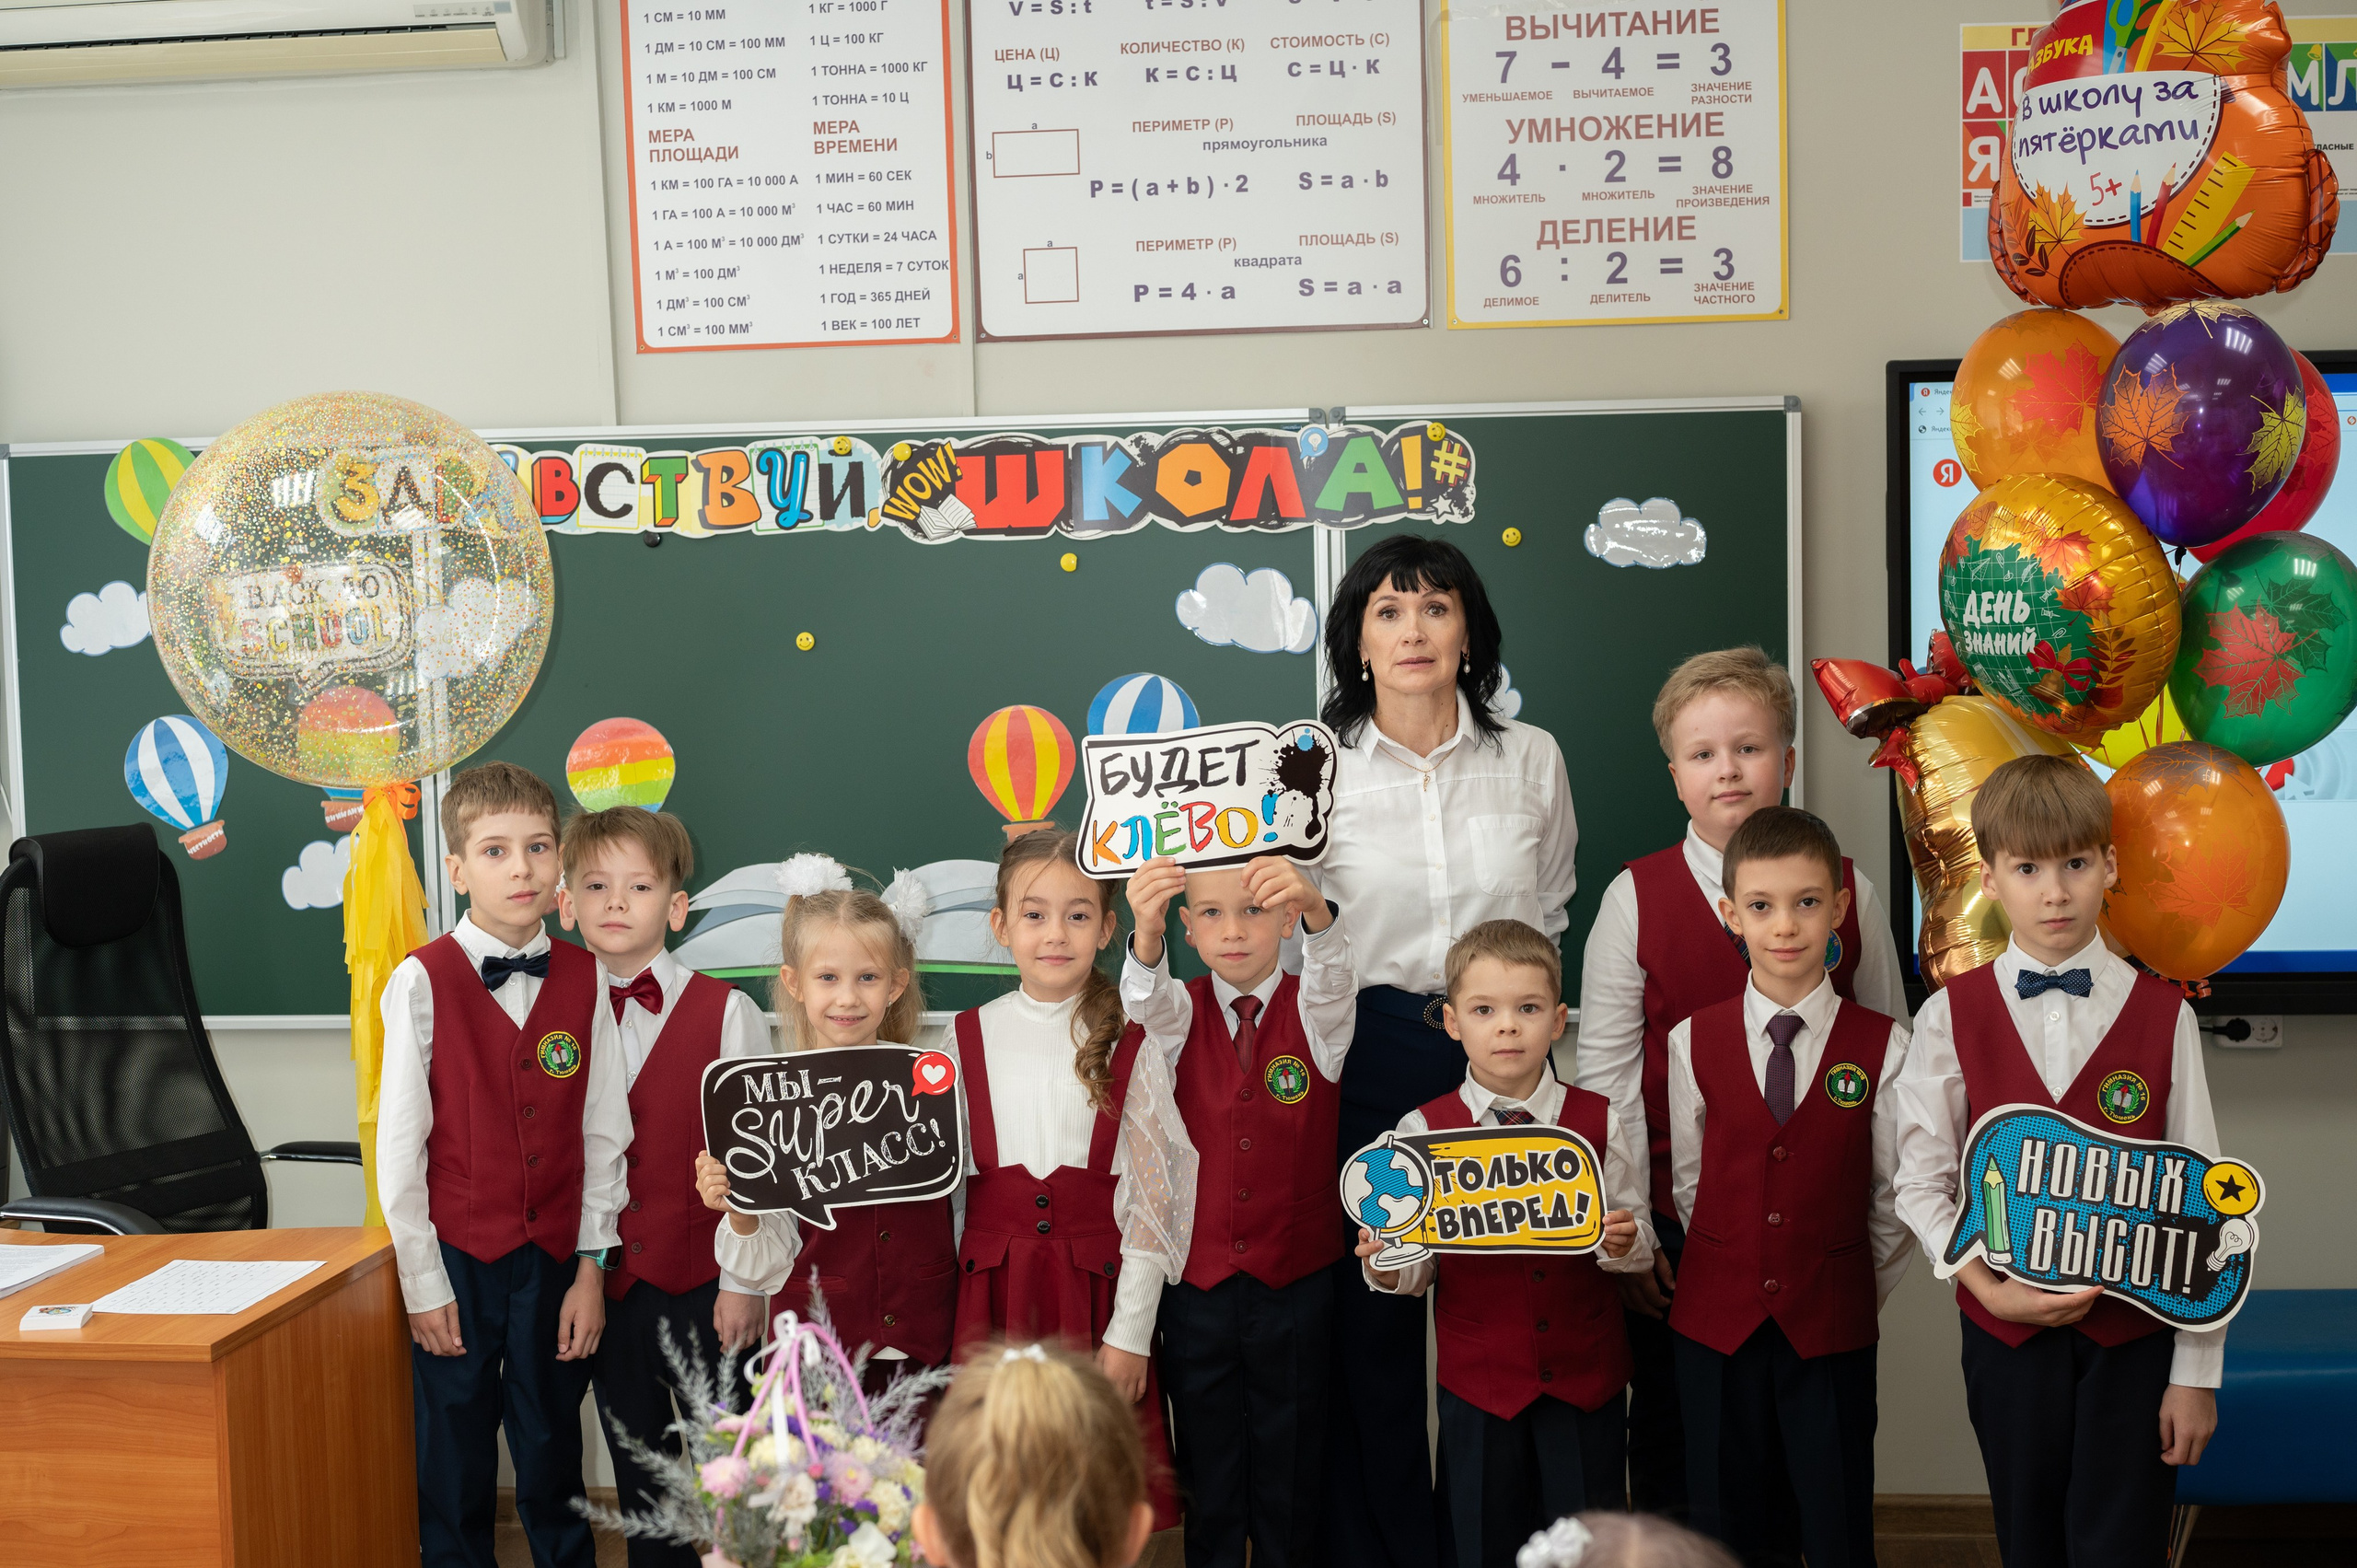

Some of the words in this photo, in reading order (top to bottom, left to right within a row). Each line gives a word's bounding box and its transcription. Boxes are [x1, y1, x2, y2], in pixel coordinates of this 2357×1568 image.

[819, 3, 834, 14] КГ
[849, 1, 877, 12] 1000
[654, 12, 673, 23] СМ
[688, 10, 702, 21] 10
[705, 9, 726, 20] ММ
[1506, 8, 1720, 41] ВЫЧИТАНИЕ
[1120, 40, 1222, 54] КОЛИЧЕСТВО
[1226, 38, 1245, 53] (К)
[1271, 34, 1364, 49] СТОИМОСТЬ
[1370, 33, 1389, 48] (С)
[995, 48, 1036, 63] ЦЕНА
[1040, 47, 1060, 63] (Ц)
[2027, 34, 2093, 75] АЗБУКА
[821, 64, 866, 75] ТОННА
[881, 63, 909, 74] 1000
[913, 62, 928, 72] КГ
[1573, 87, 1655, 99] ВЫЧИТАЕМОЕ
[1691, 81, 1752, 92] ЗНАЧЕНИЕ
[1966, 66, 2003, 113] А
[1462, 91, 1552, 103] УМЕНЬШАЕМОЕ
[1691, 94, 1752, 105] РАЗНОСТИ
[2022, 95, 2032, 122] В
[2038, 85, 2142, 118] школу
[2155, 79, 2199, 102] за
[813, 120, 860, 134] МЕРА
[1132, 119, 1211, 133] ПЕРИМЕТР
[1215, 118, 1234, 133] (P)
[1296, 112, 1373, 127] ПЛОЩАДЬ
[1377, 111, 1396, 126] (S)
[1505, 111, 1724, 144] УМНОЖЕНИЕ
[648, 128, 695, 144] МЕРА
[2019, 120, 2200, 164] пятёрками
[814, 138, 897, 155] ВРЕМЕНИ
[1202, 137, 1328, 153] прямоугольника
[649, 145, 738, 163] ПЛОЩАДИ
[826, 172, 853, 183] МИН
[869, 171, 883, 181] 60
[887, 170, 911, 181] СЕК
[1582, 190, 1655, 201] МНОЖИТЕЛЬ
[1692, 184, 1753, 195] ЗНАЧЕНИЕ
[2090, 172, 2122, 206] 5+
[1473, 193, 1546, 204] МНОЖИТЕЛЬ
[1677, 196, 1770, 208] ПРОИЗВЕДЕНИЯ
[827, 203, 853, 214] ЧАС
[868, 202, 882, 212] 60
[886, 200, 914, 211] МИН
[828, 232, 869, 244] СУТКИ
[884, 231, 898, 242] 24
[901, 230, 937, 241] ЧАСА
[1299, 233, 1376, 247] ПЛОЩАДЬ
[1380, 232, 1399, 247] (S)
[1537, 215, 1696, 250] ДЕЛЕНИЕ
[1136, 238, 1213, 252] ПЕРИМЕТР
[1218, 238, 1237, 251] (P)
[830, 262, 882, 275] НЕДЕЛЯ
[906, 260, 949, 273] СУТОК
[1235, 256, 1302, 269] квадрата
[1694, 282, 1755, 292] ЗНАЧЕНИЕ
[820, 294, 825, 304] 1
[830, 293, 856, 305] ГОД
[870, 291, 891, 302] 365
[894, 287, 930, 303] ДНЕЙ
[1483, 296, 1539, 308] ДЕЛИМОЕ
[1590, 293, 1651, 305] ДЕЛИТЕЛЬ
[1694, 294, 1755, 305] ЧАСТНОГО
[1940, 463, 1954, 483] Я
[883, 440, 963, 523] WOW!
[1962, 589, 2031, 629] ДЕНЬ
[1964, 626, 2037, 656] ЗНАНИЙ
[1100, 739, 1260, 798] БУДЕТ
[1092, 793, 1279, 866] КЛЁВО!
[790, 1118, 946, 1201] КЛАСС!
[1433, 1147, 1583, 1196] ТОЛЬКО
[2016, 1138, 2187, 1215] НОВЫХ
[1434, 1190, 1593, 1241] ВПЕРЕД!
[2028, 1207, 2199, 1295] ВЫСОТ!
